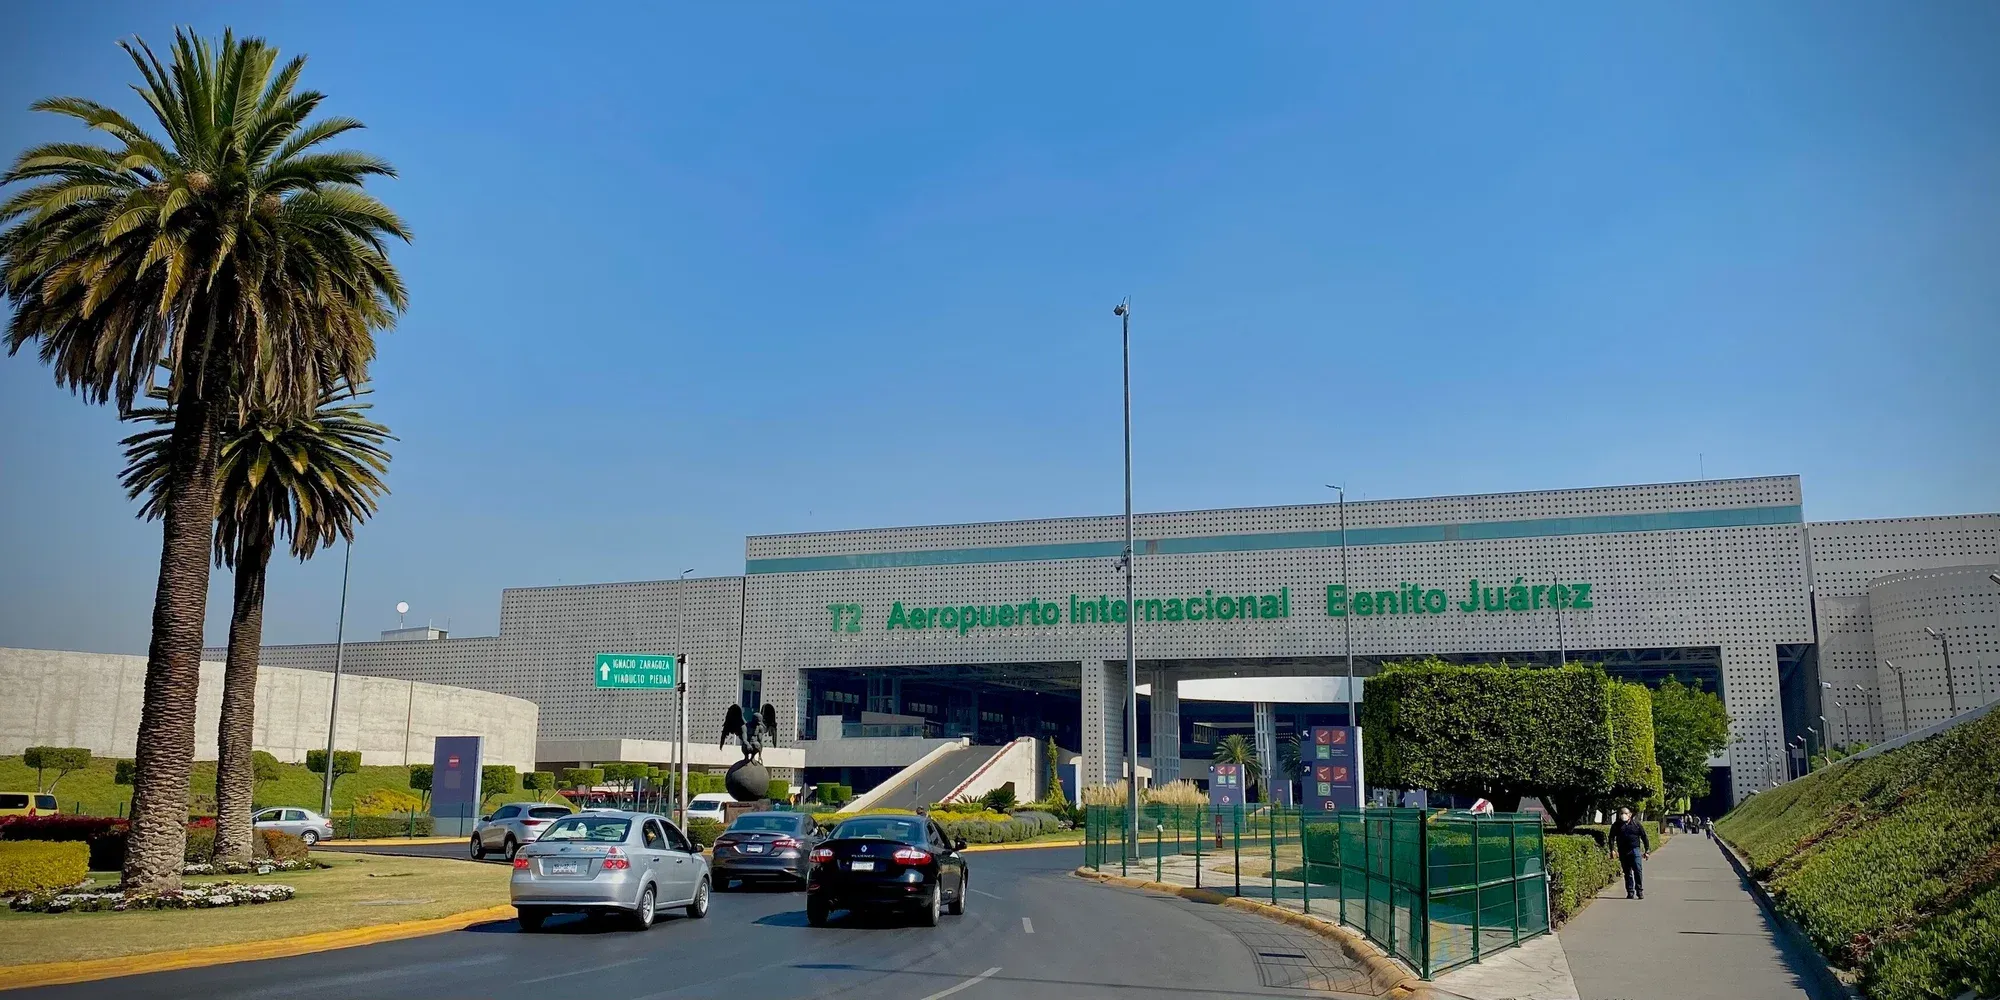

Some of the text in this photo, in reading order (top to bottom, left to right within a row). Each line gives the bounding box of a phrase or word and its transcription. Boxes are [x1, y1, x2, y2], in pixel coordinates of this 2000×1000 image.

[827, 576, 1593, 636] T2 Aeropuerto Internacional Benito Juárez
[613, 658, 670, 670] IGNACIO ZARAGOZA
[614, 674, 672, 684] VIADUCTO PIEDAD
